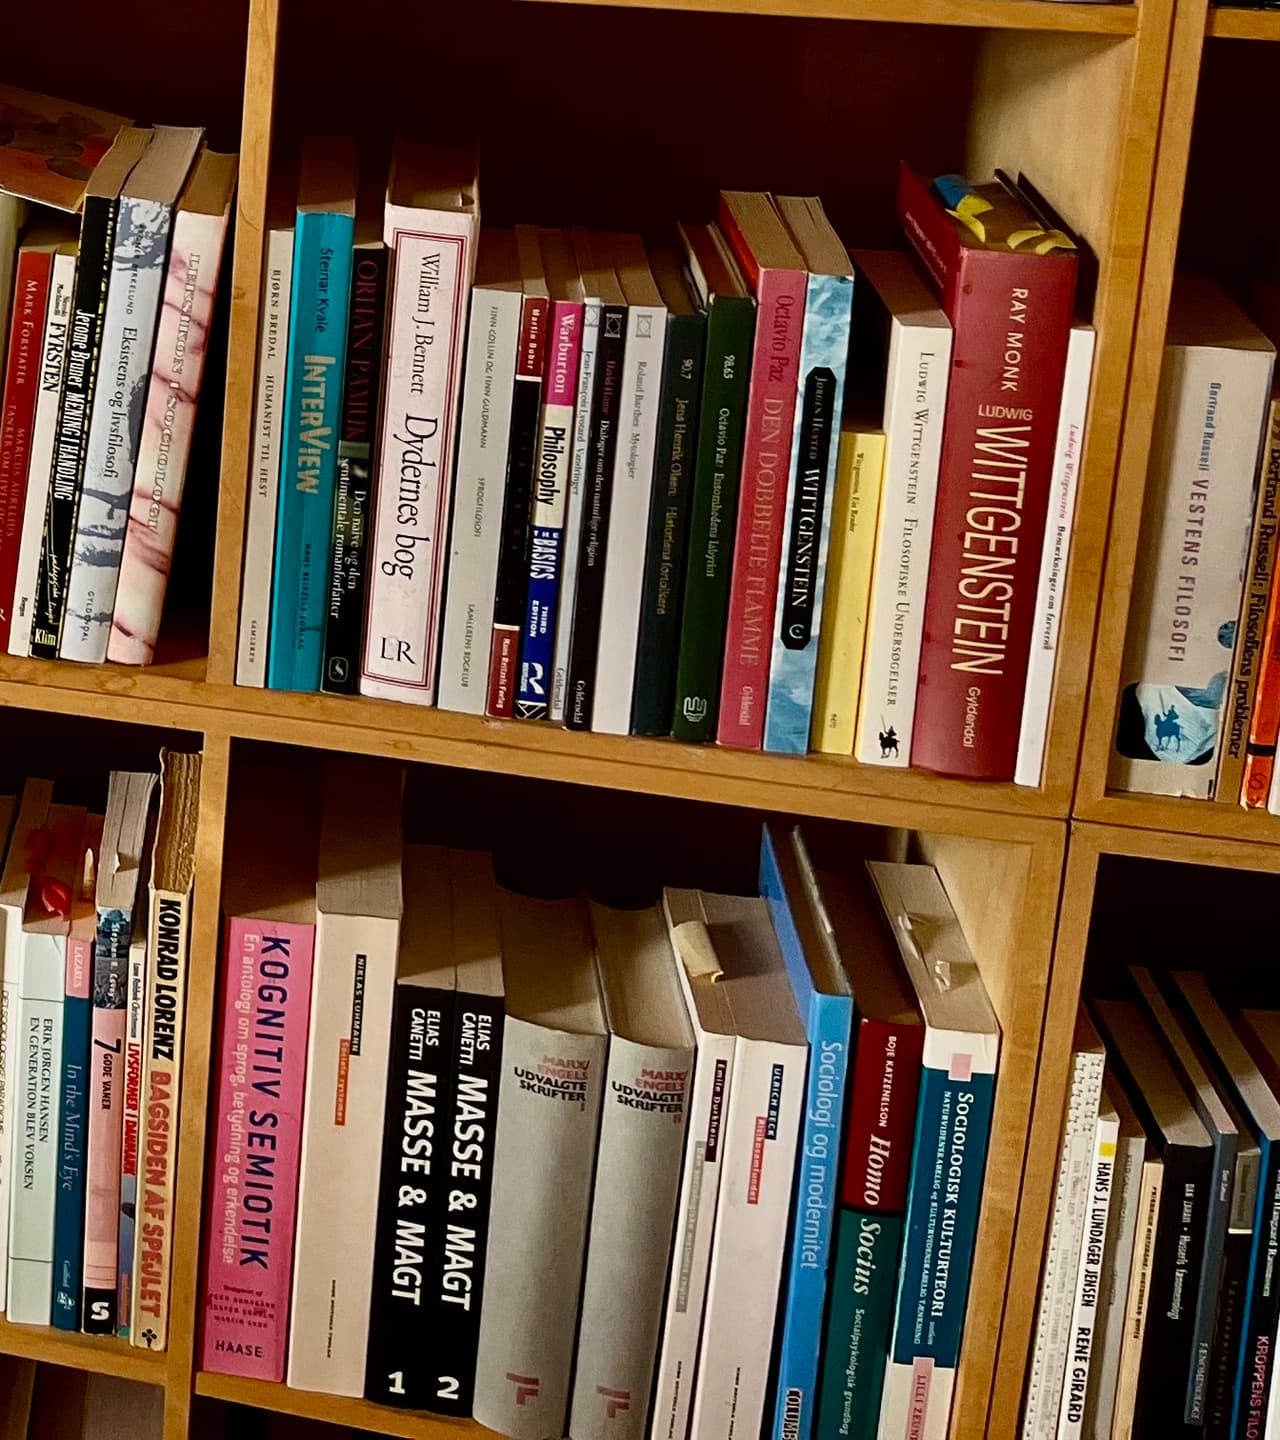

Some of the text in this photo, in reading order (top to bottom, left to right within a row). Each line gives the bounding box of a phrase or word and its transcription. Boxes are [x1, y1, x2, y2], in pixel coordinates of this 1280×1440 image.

[412, 253, 441, 314] William
[409, 337, 429, 393] Bennett
[1002, 288, 1028, 391] RAY MONK
[534, 313, 576, 508] Warburton Philosophy
[978, 404, 1032, 421] LUDWIG
[398, 414, 439, 526] Dydernes
[382, 533, 418, 581] bog
[952, 428, 1031, 675] WITTGENSTEIN
[1168, 480, 1209, 663] VESTENS FILOSOFI
[256, 935, 291, 1100] KOGNITIV
[136, 898, 181, 1316] KONRAD LORENZ BAGSIDEN AF SPEJLET
[239, 1112, 278, 1270] SEMIOTIK
[392, 1069, 438, 1305] MASSE & MAGT
[864, 1133, 891, 1206] Homo
[1098, 1162, 1112, 1194] HANS
[853, 1218, 881, 1295] Socius
[1086, 1207, 1109, 1265] LUNDAGER
[1081, 1268, 1099, 1308] JENSEN
[216, 1339, 263, 1358] HAASE
[1067, 1367, 1088, 1423] GIRARD
